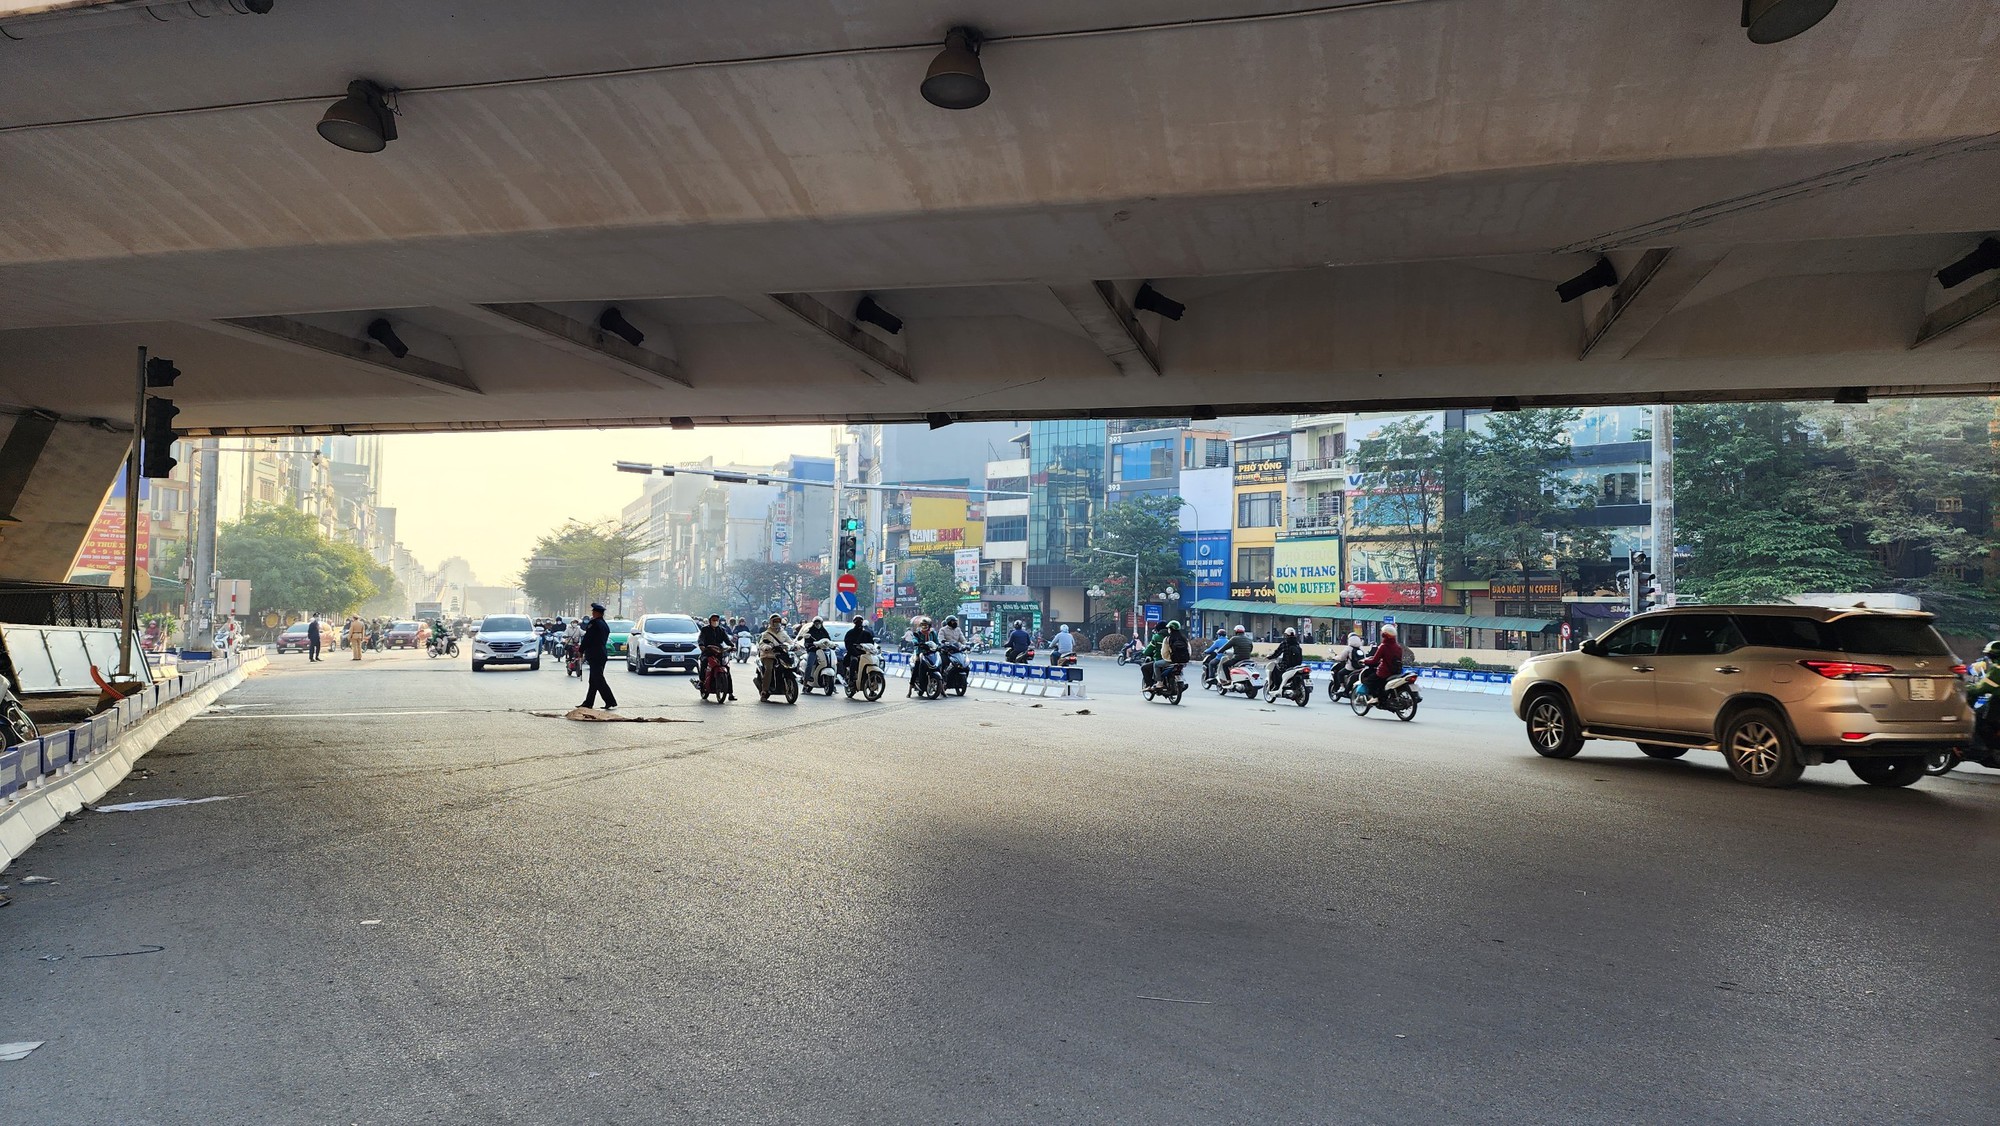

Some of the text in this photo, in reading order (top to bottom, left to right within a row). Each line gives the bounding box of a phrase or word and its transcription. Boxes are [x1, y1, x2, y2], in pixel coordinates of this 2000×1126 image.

[1276, 565, 1336, 578] BÚN THANG
[1278, 581, 1336, 594] CƠM BUFFET
[1507, 584, 1534, 594] NGUYN
[1535, 584, 1558, 594] COFFEE
